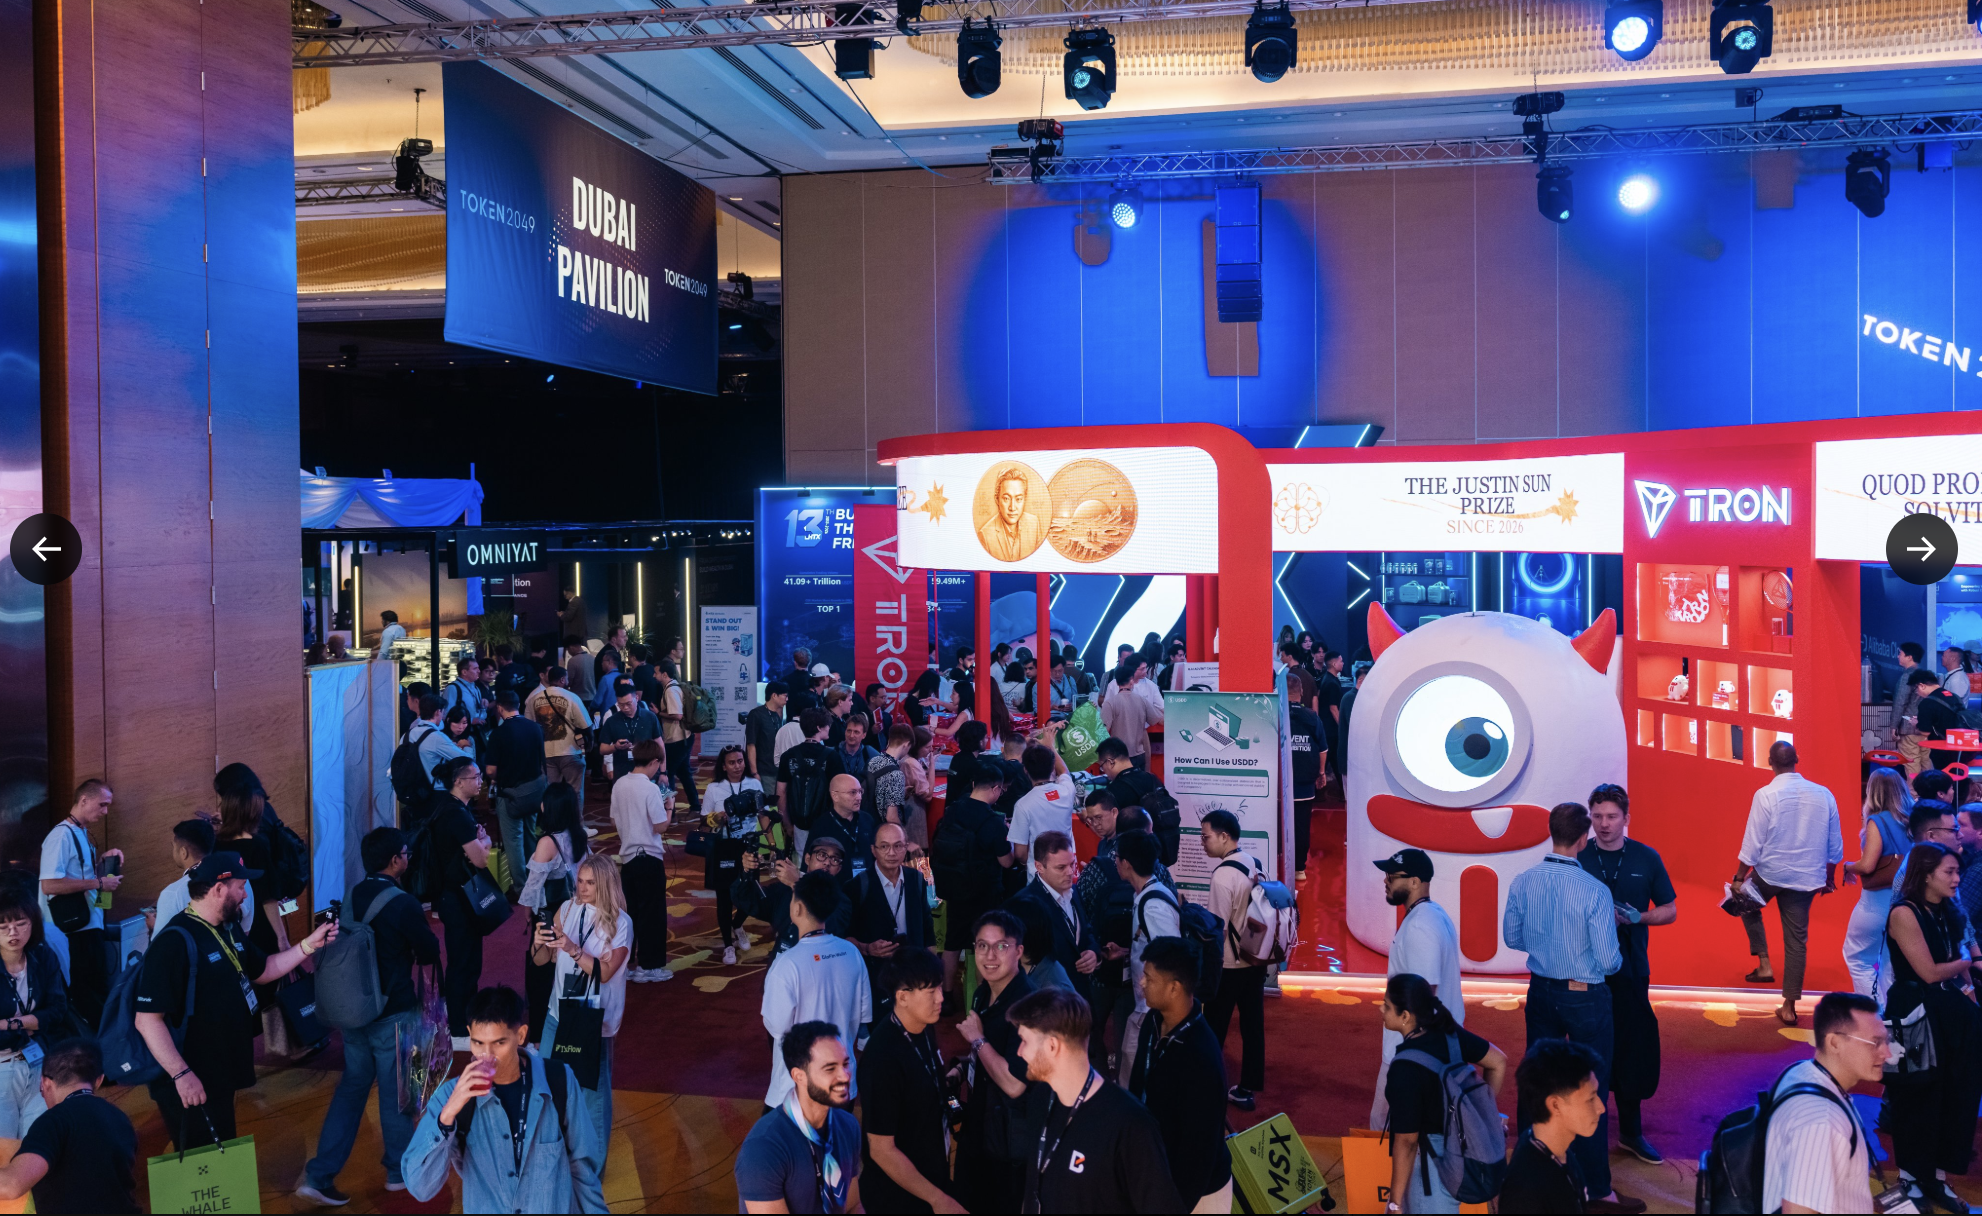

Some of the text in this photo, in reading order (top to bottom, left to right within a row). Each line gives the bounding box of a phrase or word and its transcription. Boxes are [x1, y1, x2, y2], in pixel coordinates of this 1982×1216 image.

[460, 189, 536, 233] TOKEN2049
[573, 176, 636, 251] DUBAI
[557, 244, 649, 323] PAVILION
[664, 268, 708, 298] TOKEN2049
[1863, 314, 1982, 379] TOKEN
[1405, 474, 1551, 495] THE JUSTIN SUN
[1862, 472, 1982, 500] QUOD PRO
[1460, 496, 1515, 515] PRIZE
[1684, 484, 1792, 526] TRON
[784, 509, 824, 547] 13
[1447, 520, 1524, 534] SINCE 2026
[467, 542, 538, 566] OMNIYAT
[832, 537, 854, 549] FR
[813, 577, 841, 585] Trillion
[1075, 739, 1097, 757] USDD
[1193, 757, 1210, 765] Can
[1267, 1123, 1291, 1205] MSX
[182, 1197, 231, 1214] WHALE
[191, 1185, 220, 1202] THE
